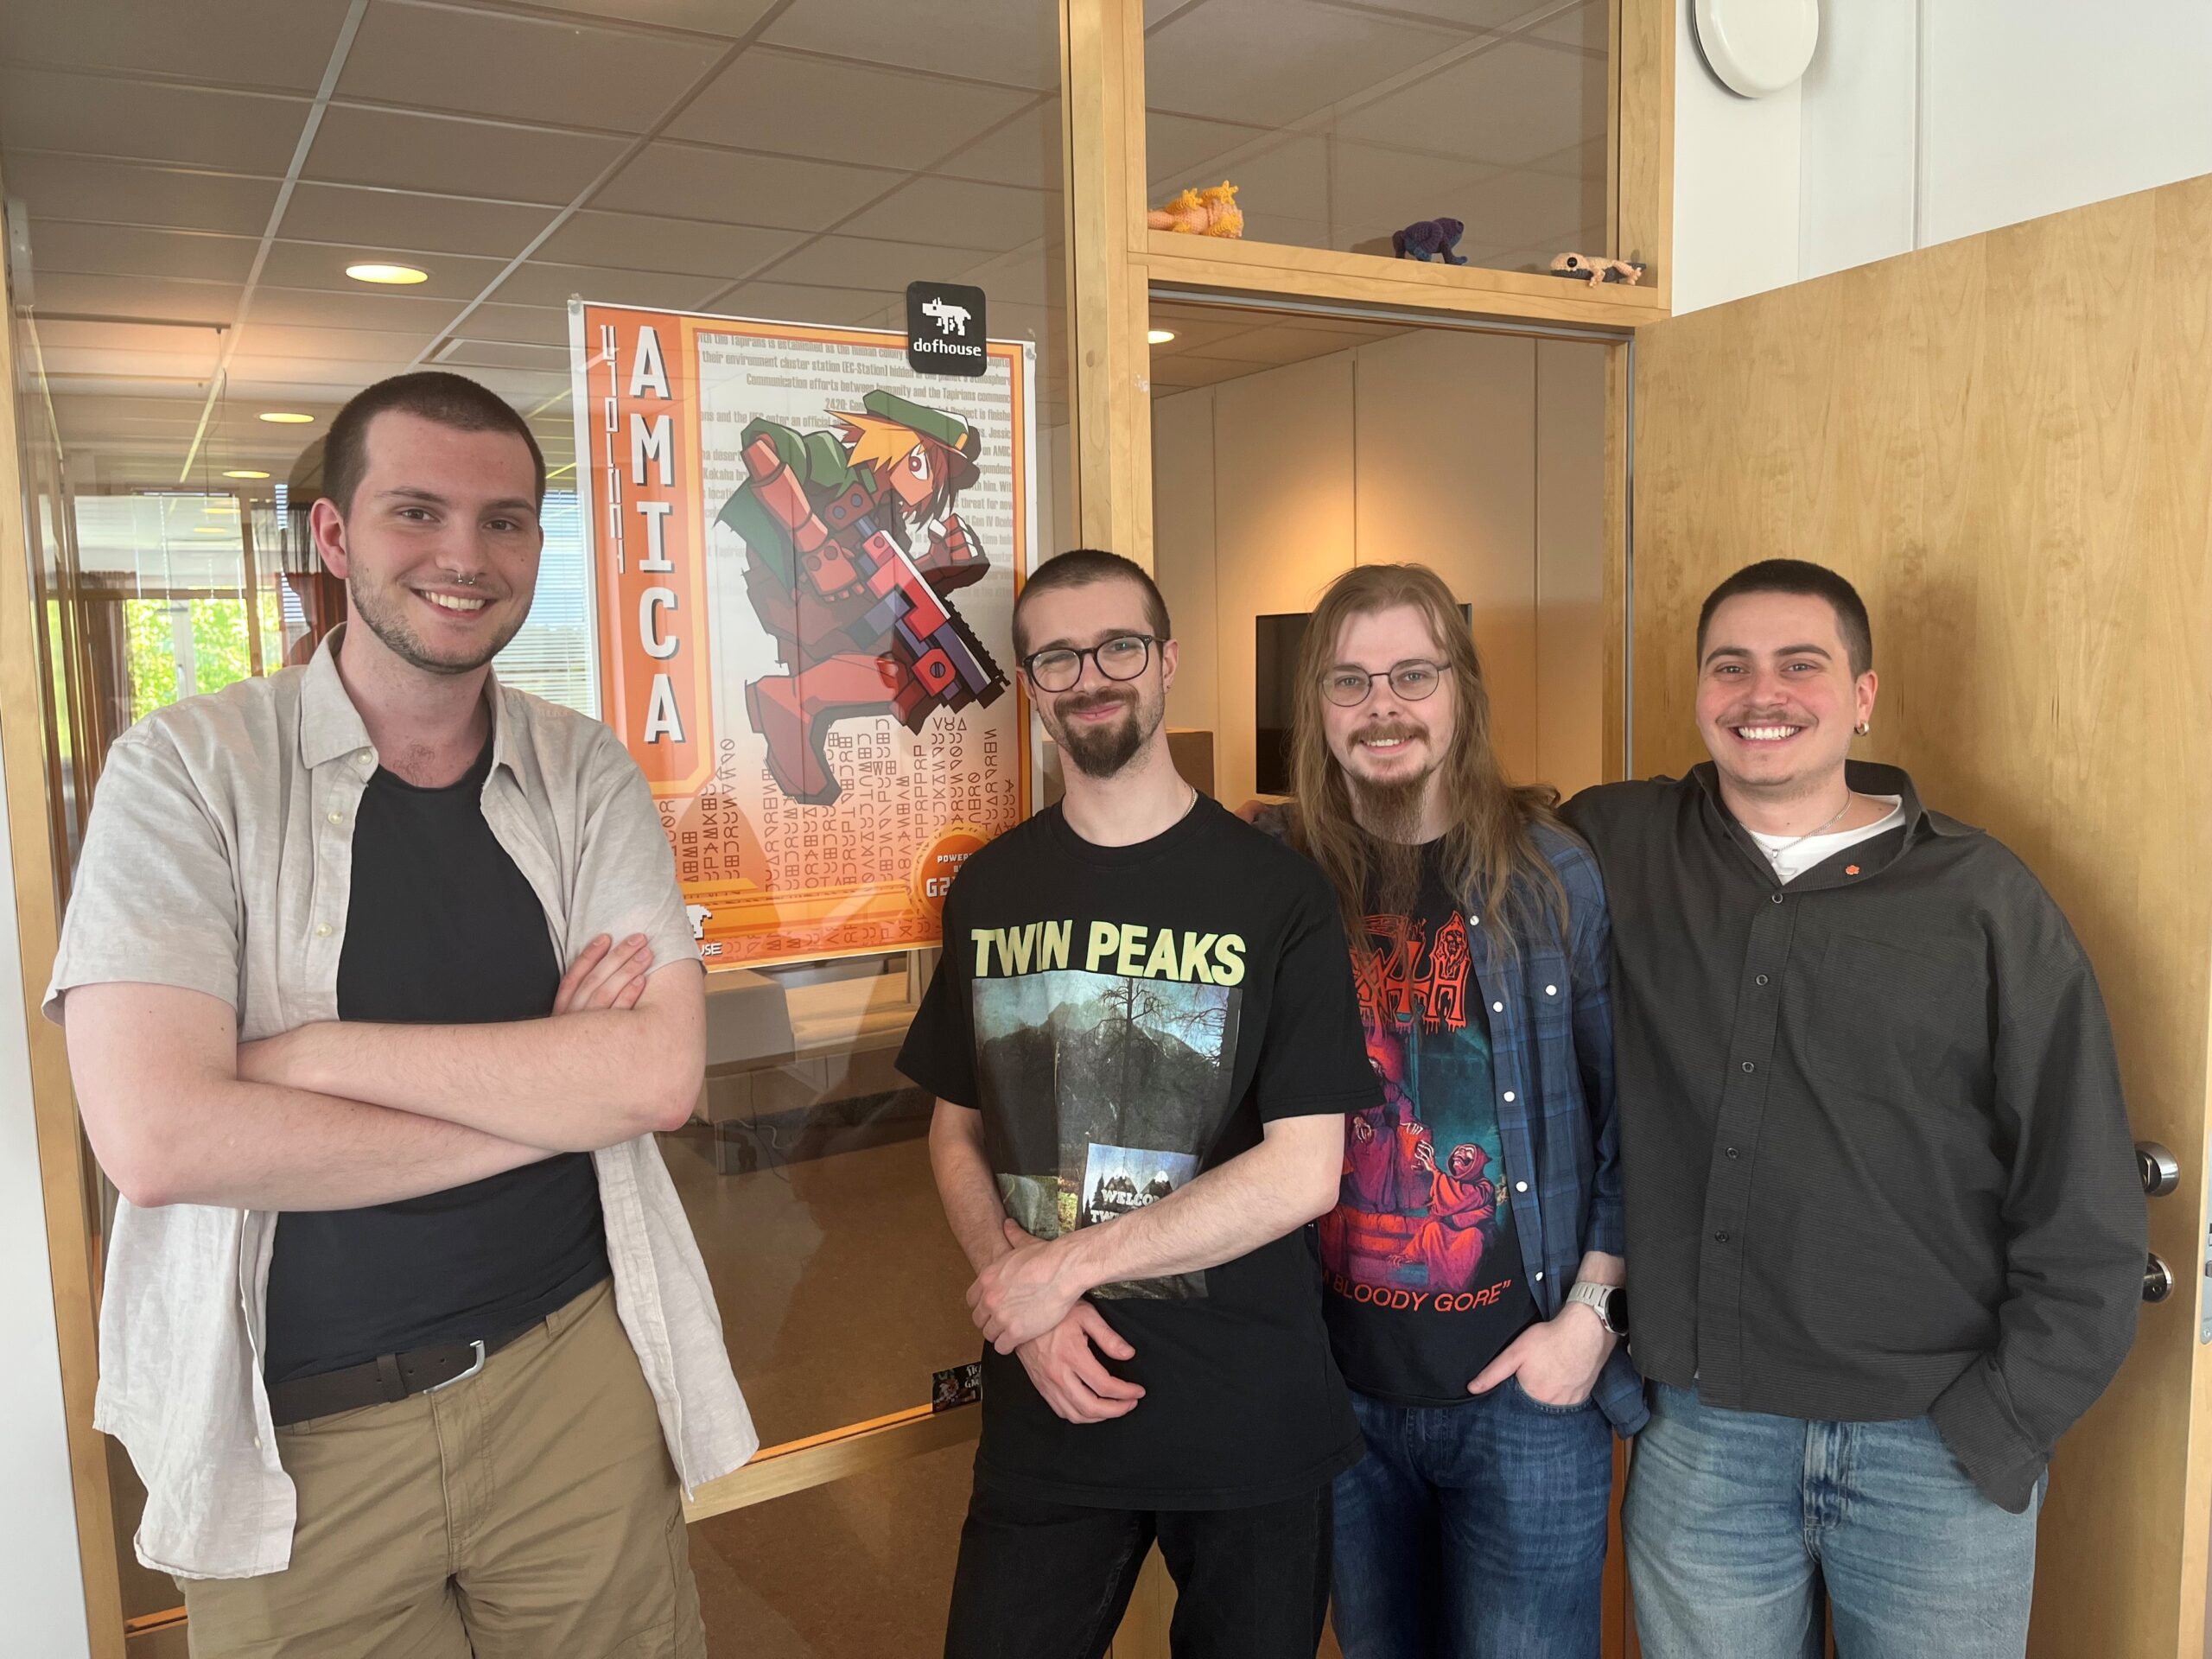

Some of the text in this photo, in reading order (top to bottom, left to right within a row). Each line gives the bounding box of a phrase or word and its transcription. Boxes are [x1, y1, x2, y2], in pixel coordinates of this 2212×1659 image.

[913, 338, 982, 357] dofhouse
[702, 350, 724, 364] their
[726, 353, 778, 368] environment
[780, 356, 810, 370] cluster
[811, 359, 841, 372] station
[889, 365, 914, 378] hidden
[746, 372, 807, 389] Communication
[809, 378, 838, 391] efforts
[841, 380, 874, 393] between
[913, 386, 926, 397] and
[929, 386, 941, 398] the
[849, 398, 867, 412] Gen
[980, 408, 986, 420] is
[716, 410, 732, 423] and
[734, 410, 747, 423] the
[791, 416, 800, 427] an
[803, 415, 830, 429] official
[961, 497, 986, 510] threat
[987, 498, 998, 510] for
[628, 325, 684, 743] AMICA
[926, 876, 955, 897] G2
[971, 920, 1072, 977] TWIN
[1085, 921, 1247, 987] PEAKS
[1333, 1274, 1429, 1313] BLOODY
